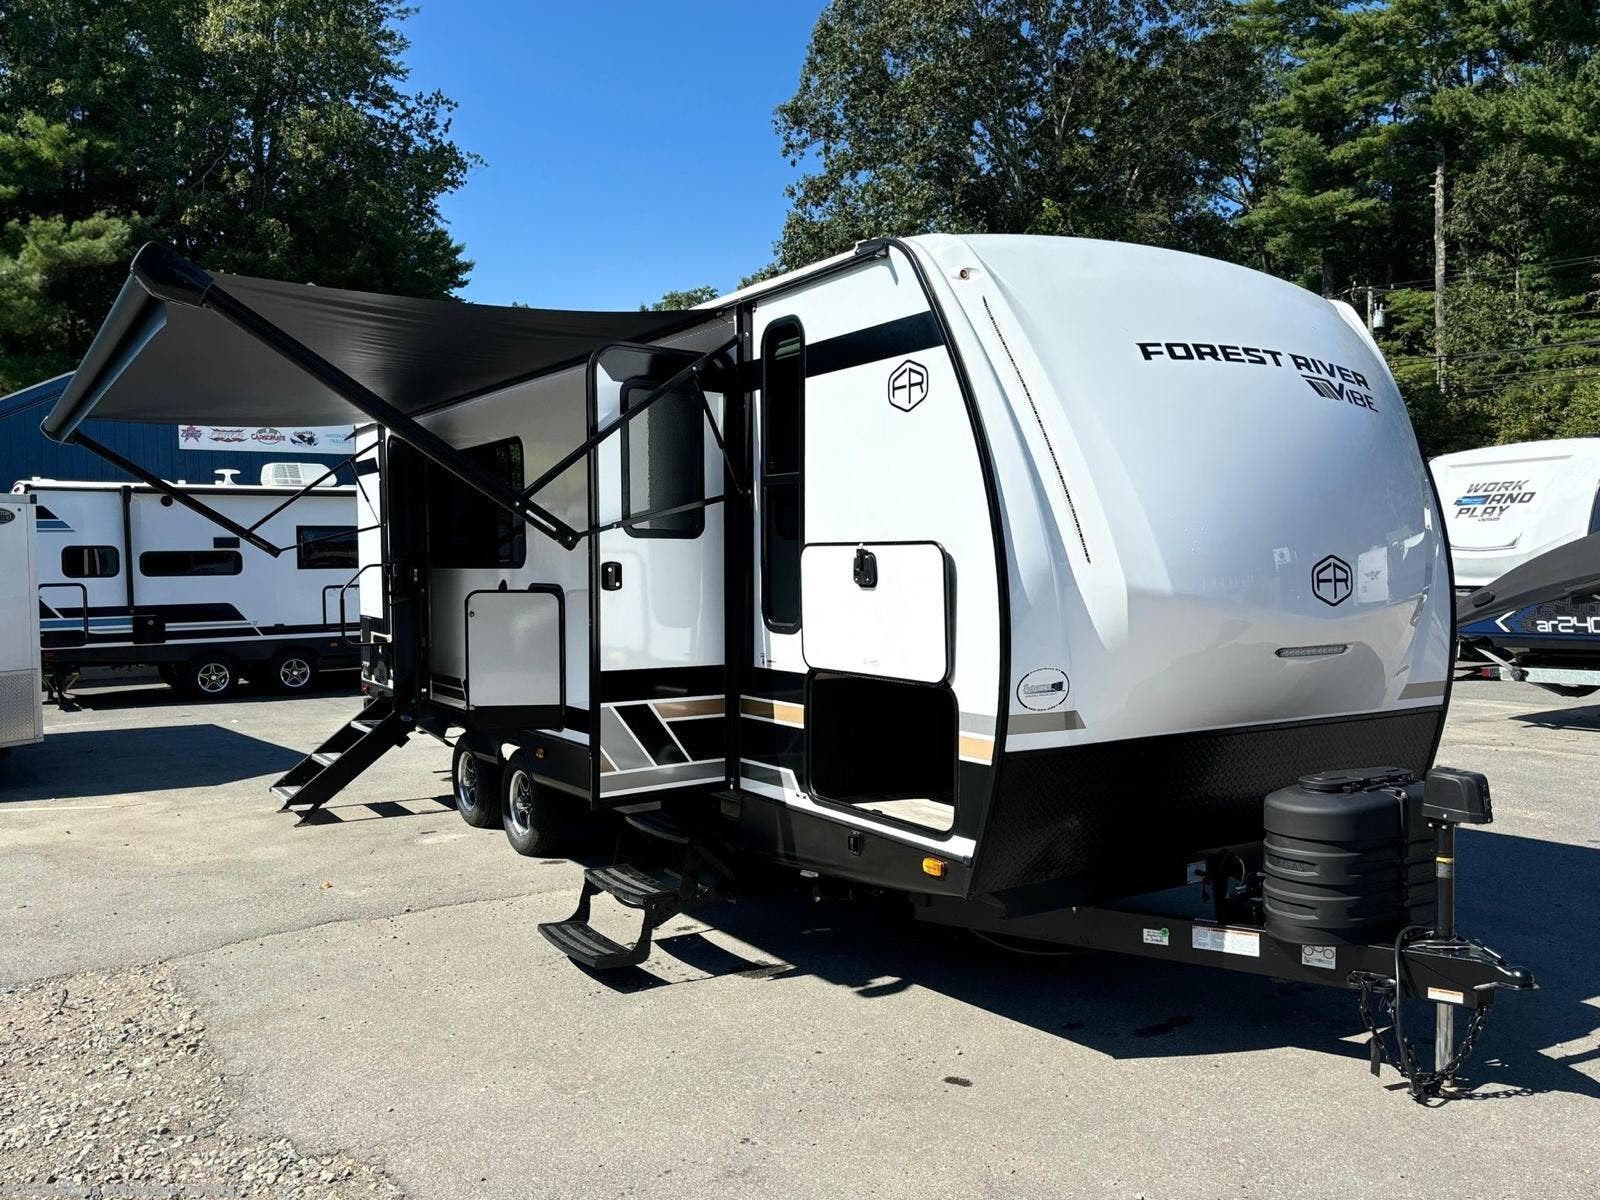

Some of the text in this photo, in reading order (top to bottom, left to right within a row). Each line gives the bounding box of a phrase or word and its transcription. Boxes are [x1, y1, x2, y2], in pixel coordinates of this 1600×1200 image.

[1136, 342, 1372, 391] FOREST RIVER
[1466, 479, 1530, 494] WORK
[1487, 491, 1537, 505] AND
[1454, 505, 1511, 519] PLAY
